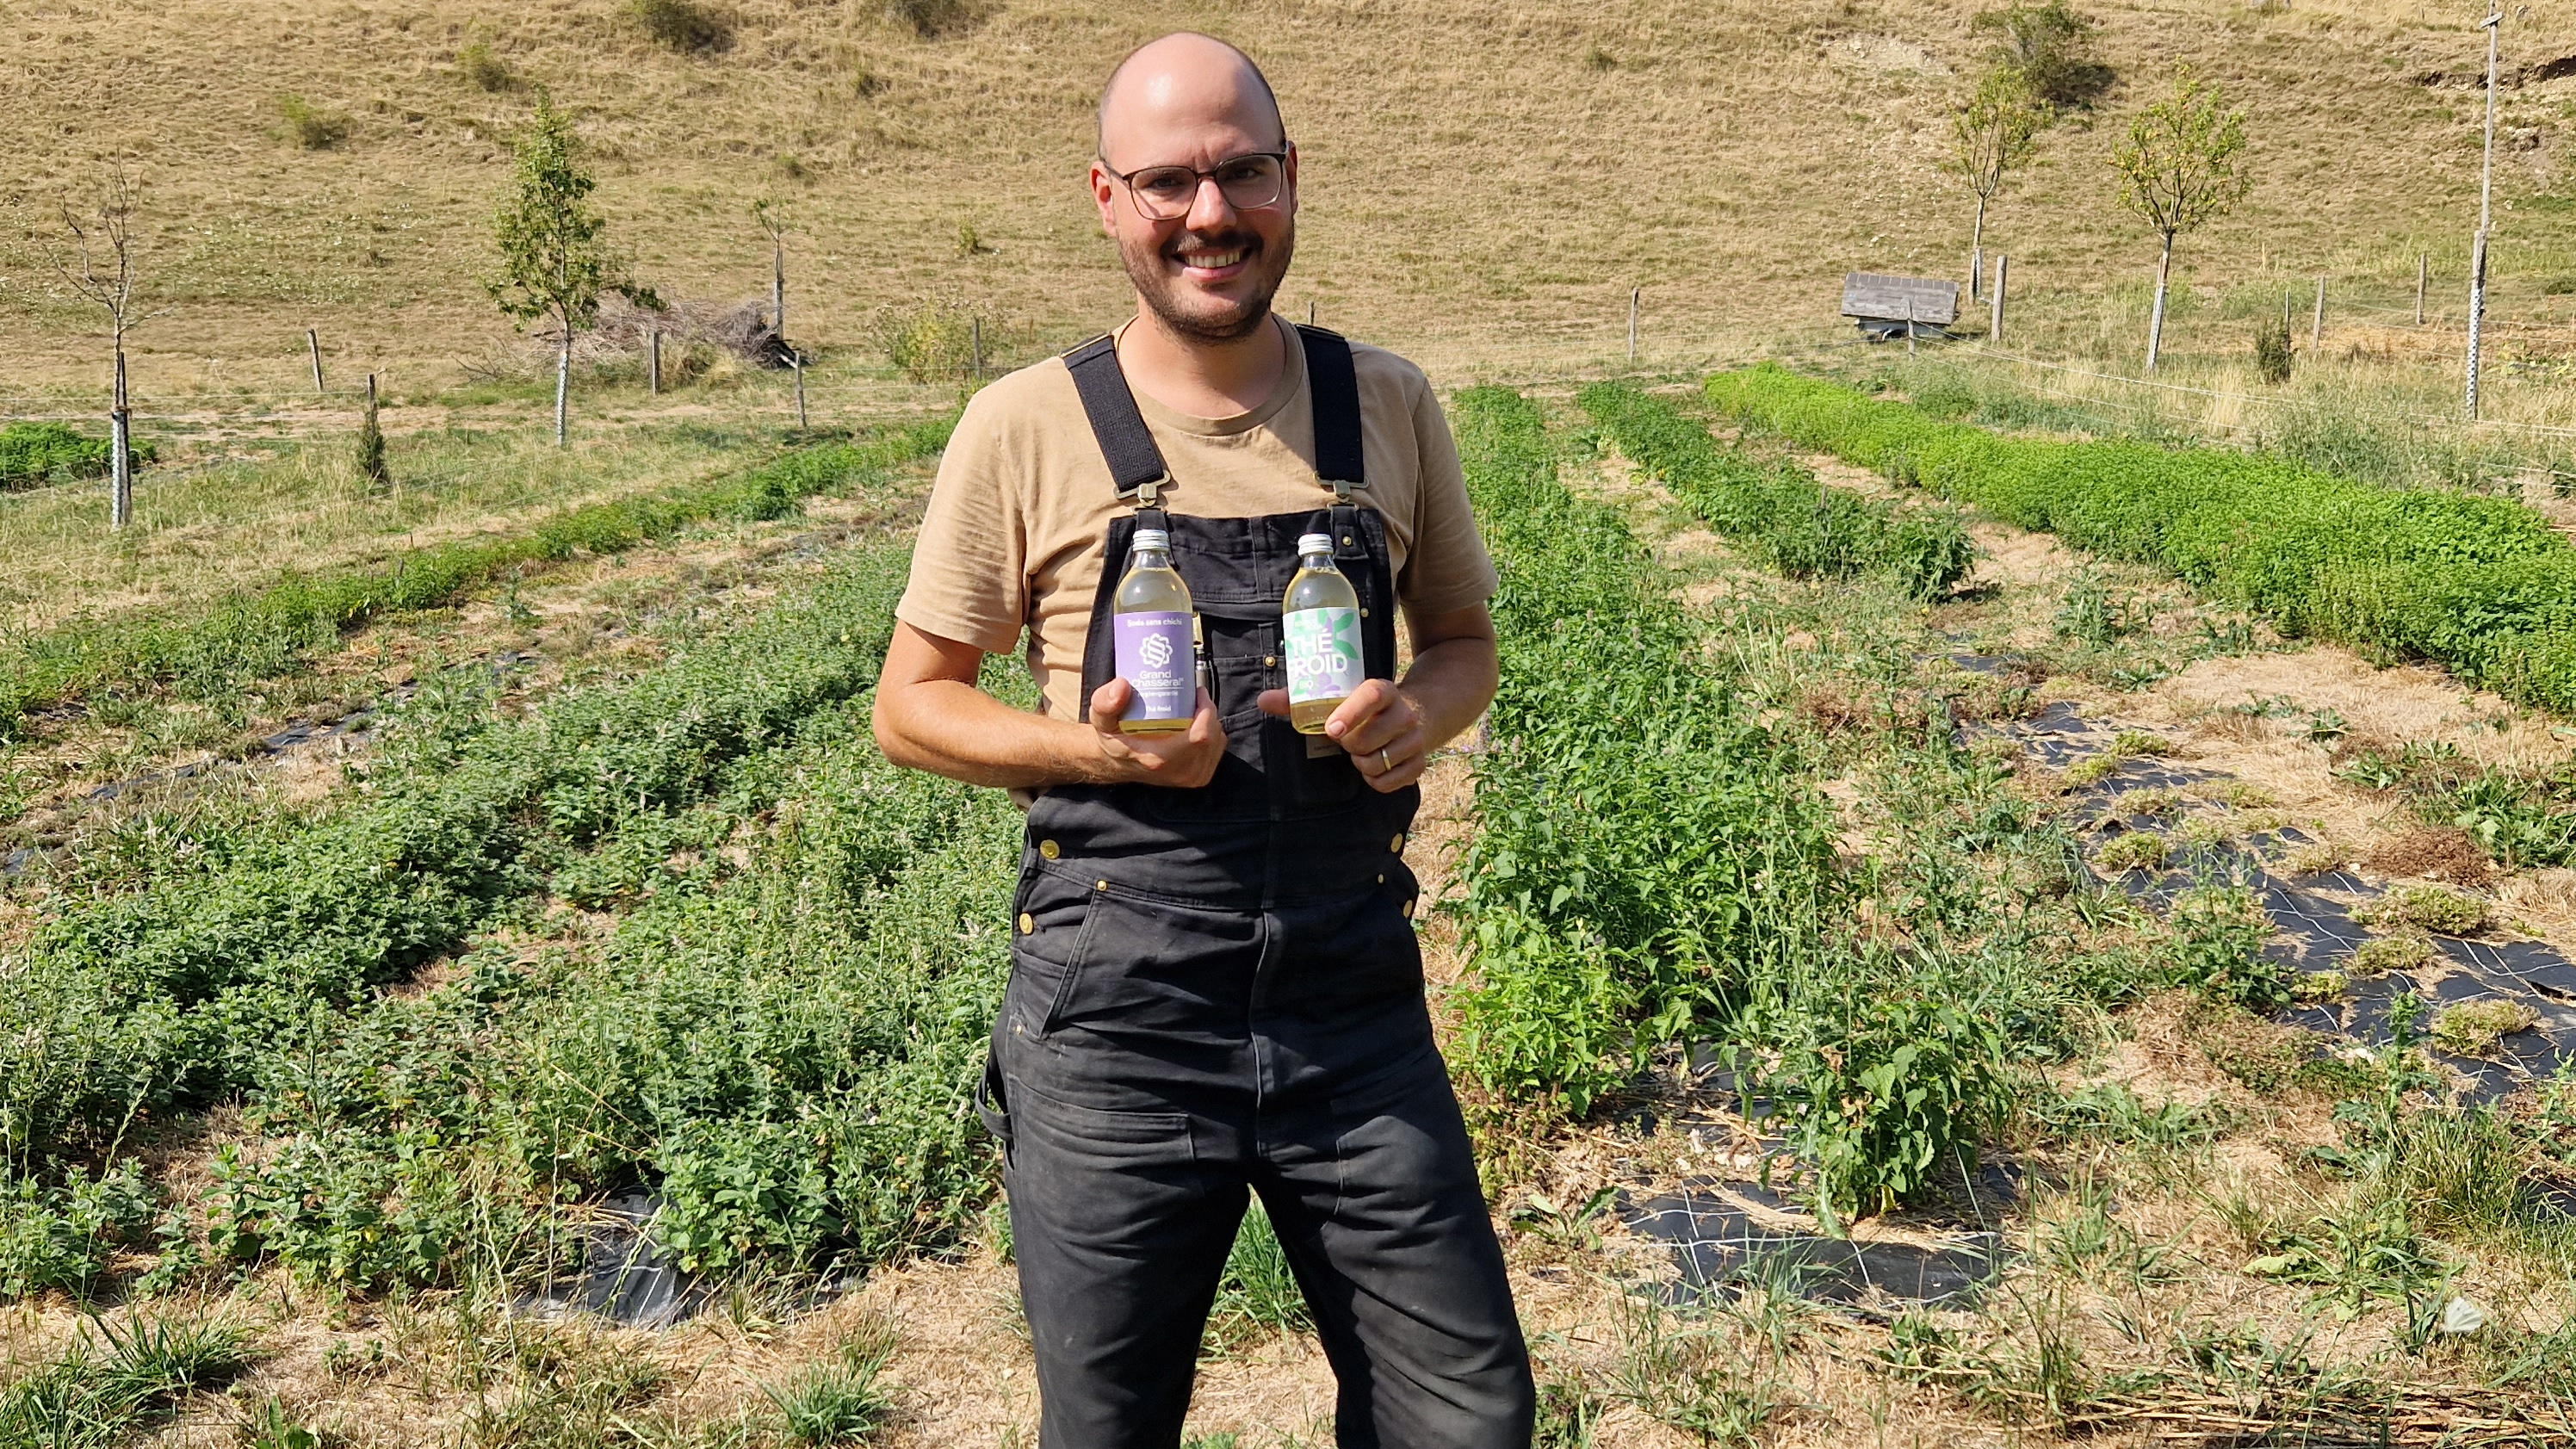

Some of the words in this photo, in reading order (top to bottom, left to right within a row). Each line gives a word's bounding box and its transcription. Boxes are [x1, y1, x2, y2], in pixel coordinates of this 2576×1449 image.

[1163, 617, 1183, 626] chichi
[1290, 628, 1333, 657] THÉ
[1139, 669, 1172, 679] Grand
[1287, 653, 1347, 680] FROID
